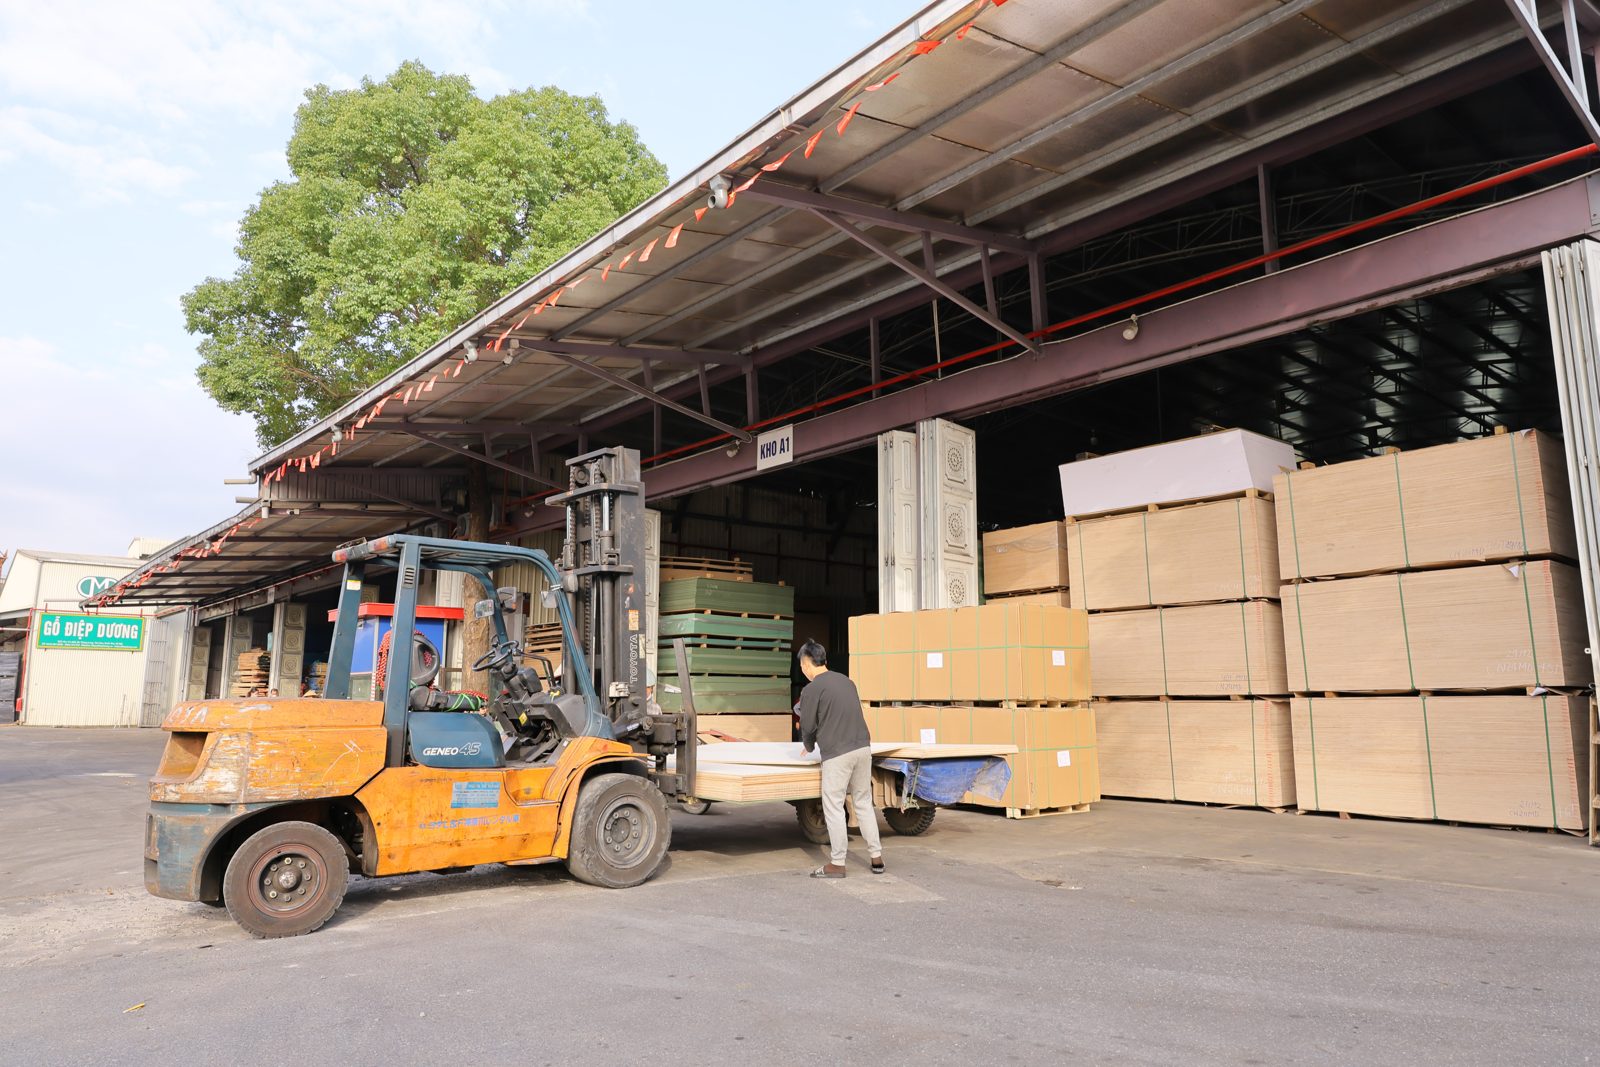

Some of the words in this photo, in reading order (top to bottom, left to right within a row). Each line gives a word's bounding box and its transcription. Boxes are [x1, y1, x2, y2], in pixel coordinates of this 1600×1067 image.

[761, 440, 777, 460] KHO
[779, 436, 790, 454] A1
[43, 616, 61, 636] GỖ
[64, 619, 94, 640] ĐIỆP
[96, 622, 139, 639] DƯƠNG
[629, 633, 638, 684] TOYOTA
[422, 747, 459, 756] GENEO
[460, 742, 482, 756] 45
